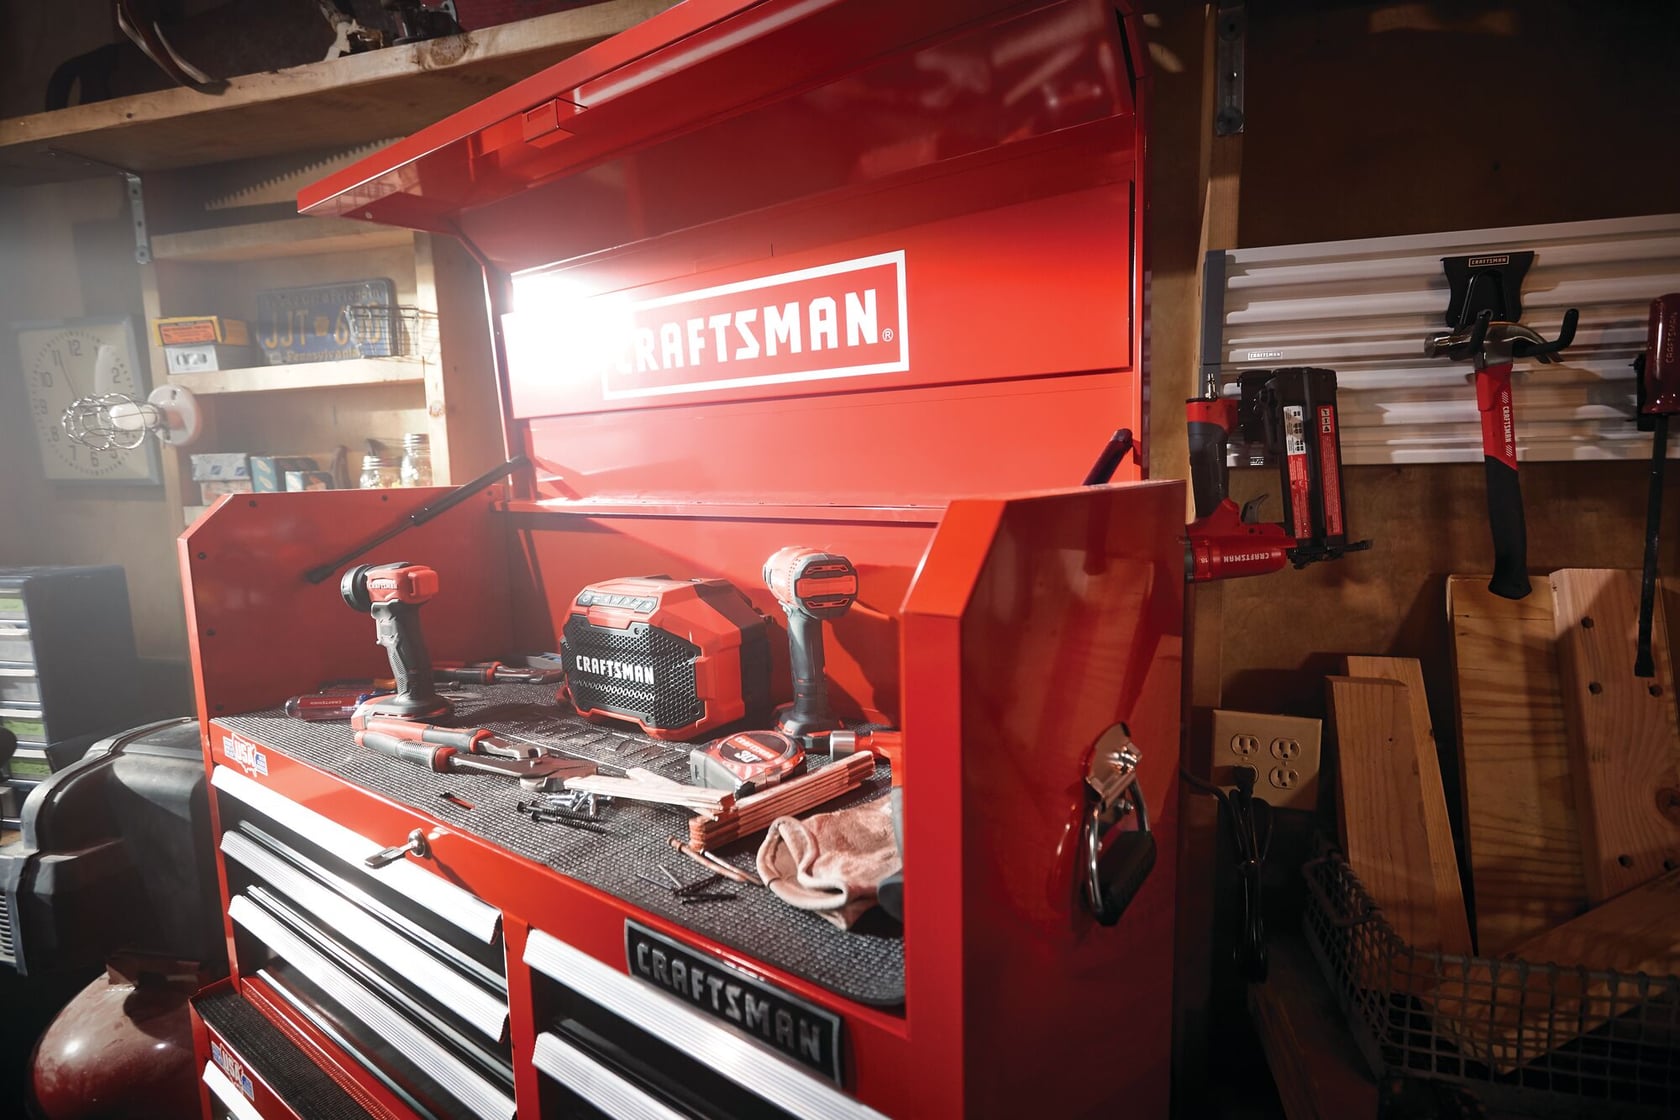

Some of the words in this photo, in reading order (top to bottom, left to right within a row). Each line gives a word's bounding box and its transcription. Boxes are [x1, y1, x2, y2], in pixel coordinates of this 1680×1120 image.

[1471, 257, 1507, 265] CRAFTSMAN
[265, 309, 309, 349] JJT
[68, 339, 83, 357] 12
[286, 347, 360, 362] Pennsylvania
[111, 367, 121, 384] 2
[1502, 406, 1512, 443] CRAFTSMAN
[67, 444, 77, 461] 7
[1223, 552, 1270, 563] CRAFTSMAN
[576, 655, 655, 685] CRAFTSMAN
[733, 736, 777, 761] CRAFTSMAN
[636, 941, 822, 1063] CRAFTSMAN
